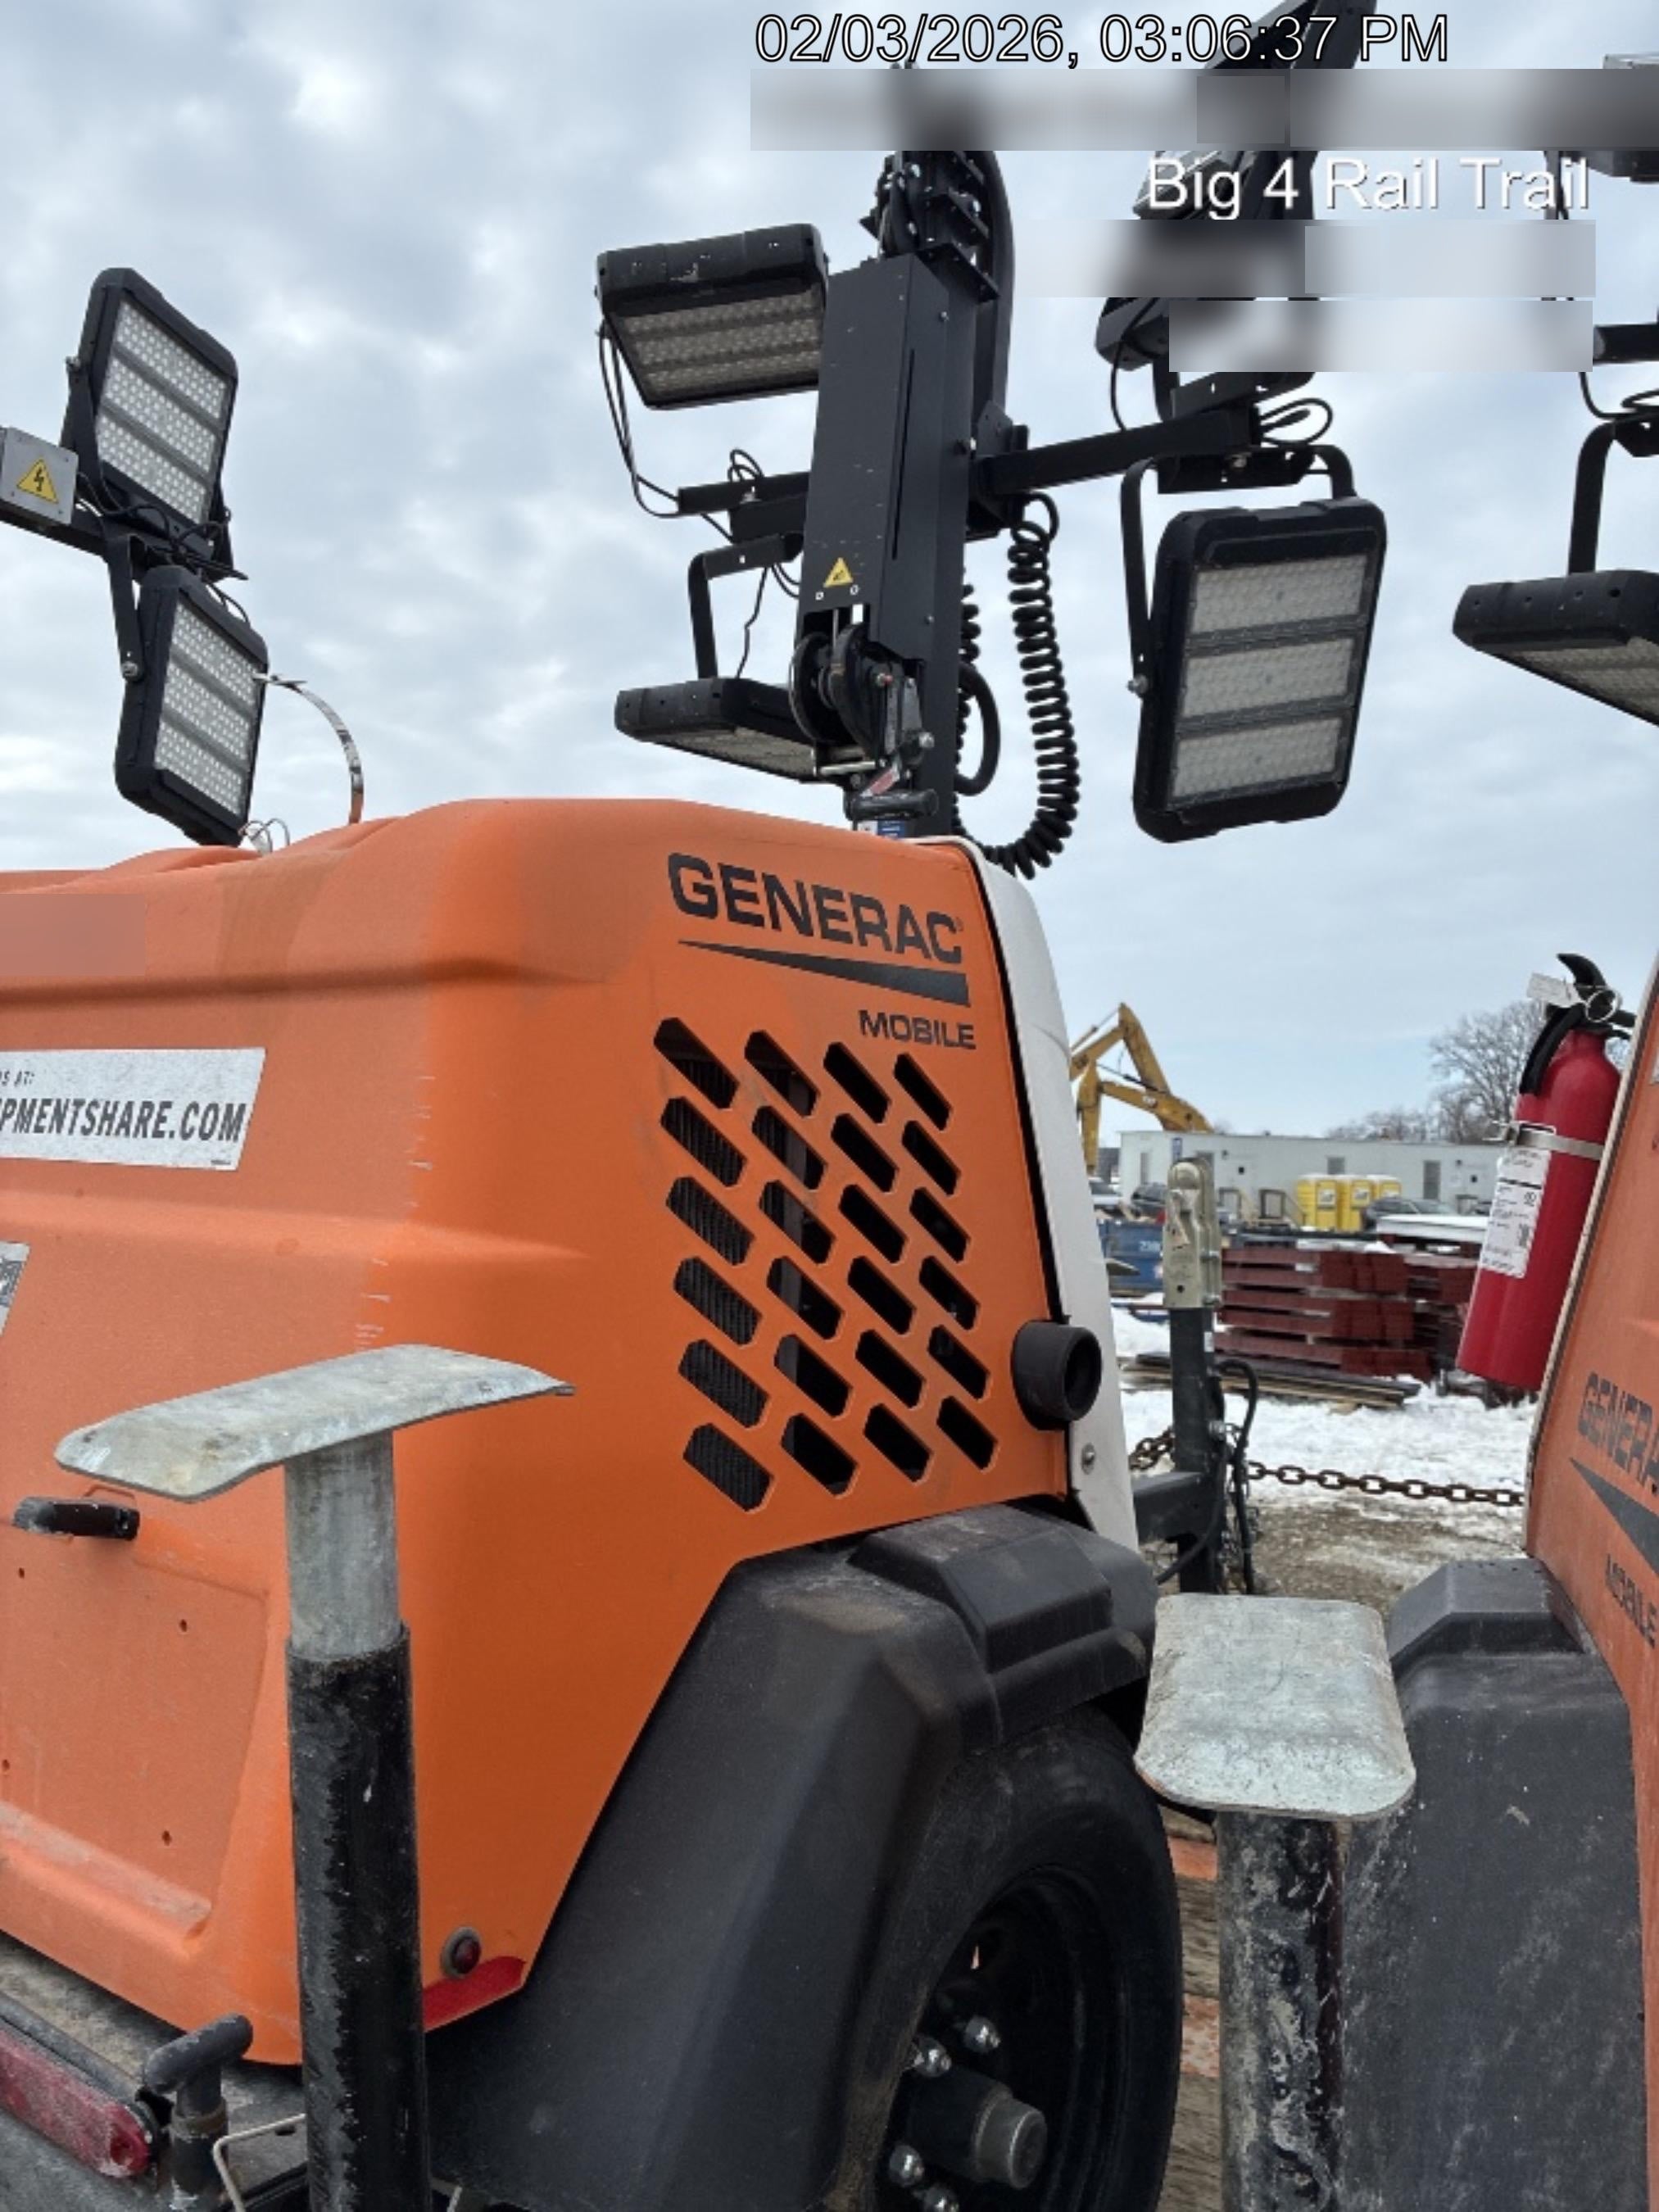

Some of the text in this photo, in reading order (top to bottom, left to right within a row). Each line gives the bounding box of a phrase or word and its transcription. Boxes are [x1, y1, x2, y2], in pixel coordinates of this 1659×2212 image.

[668, 852, 963, 964] GENERAC
[859, 1009, 977, 1050] MOBILE
[0, 1098, 246, 1143] PMENTSHARE.COM
